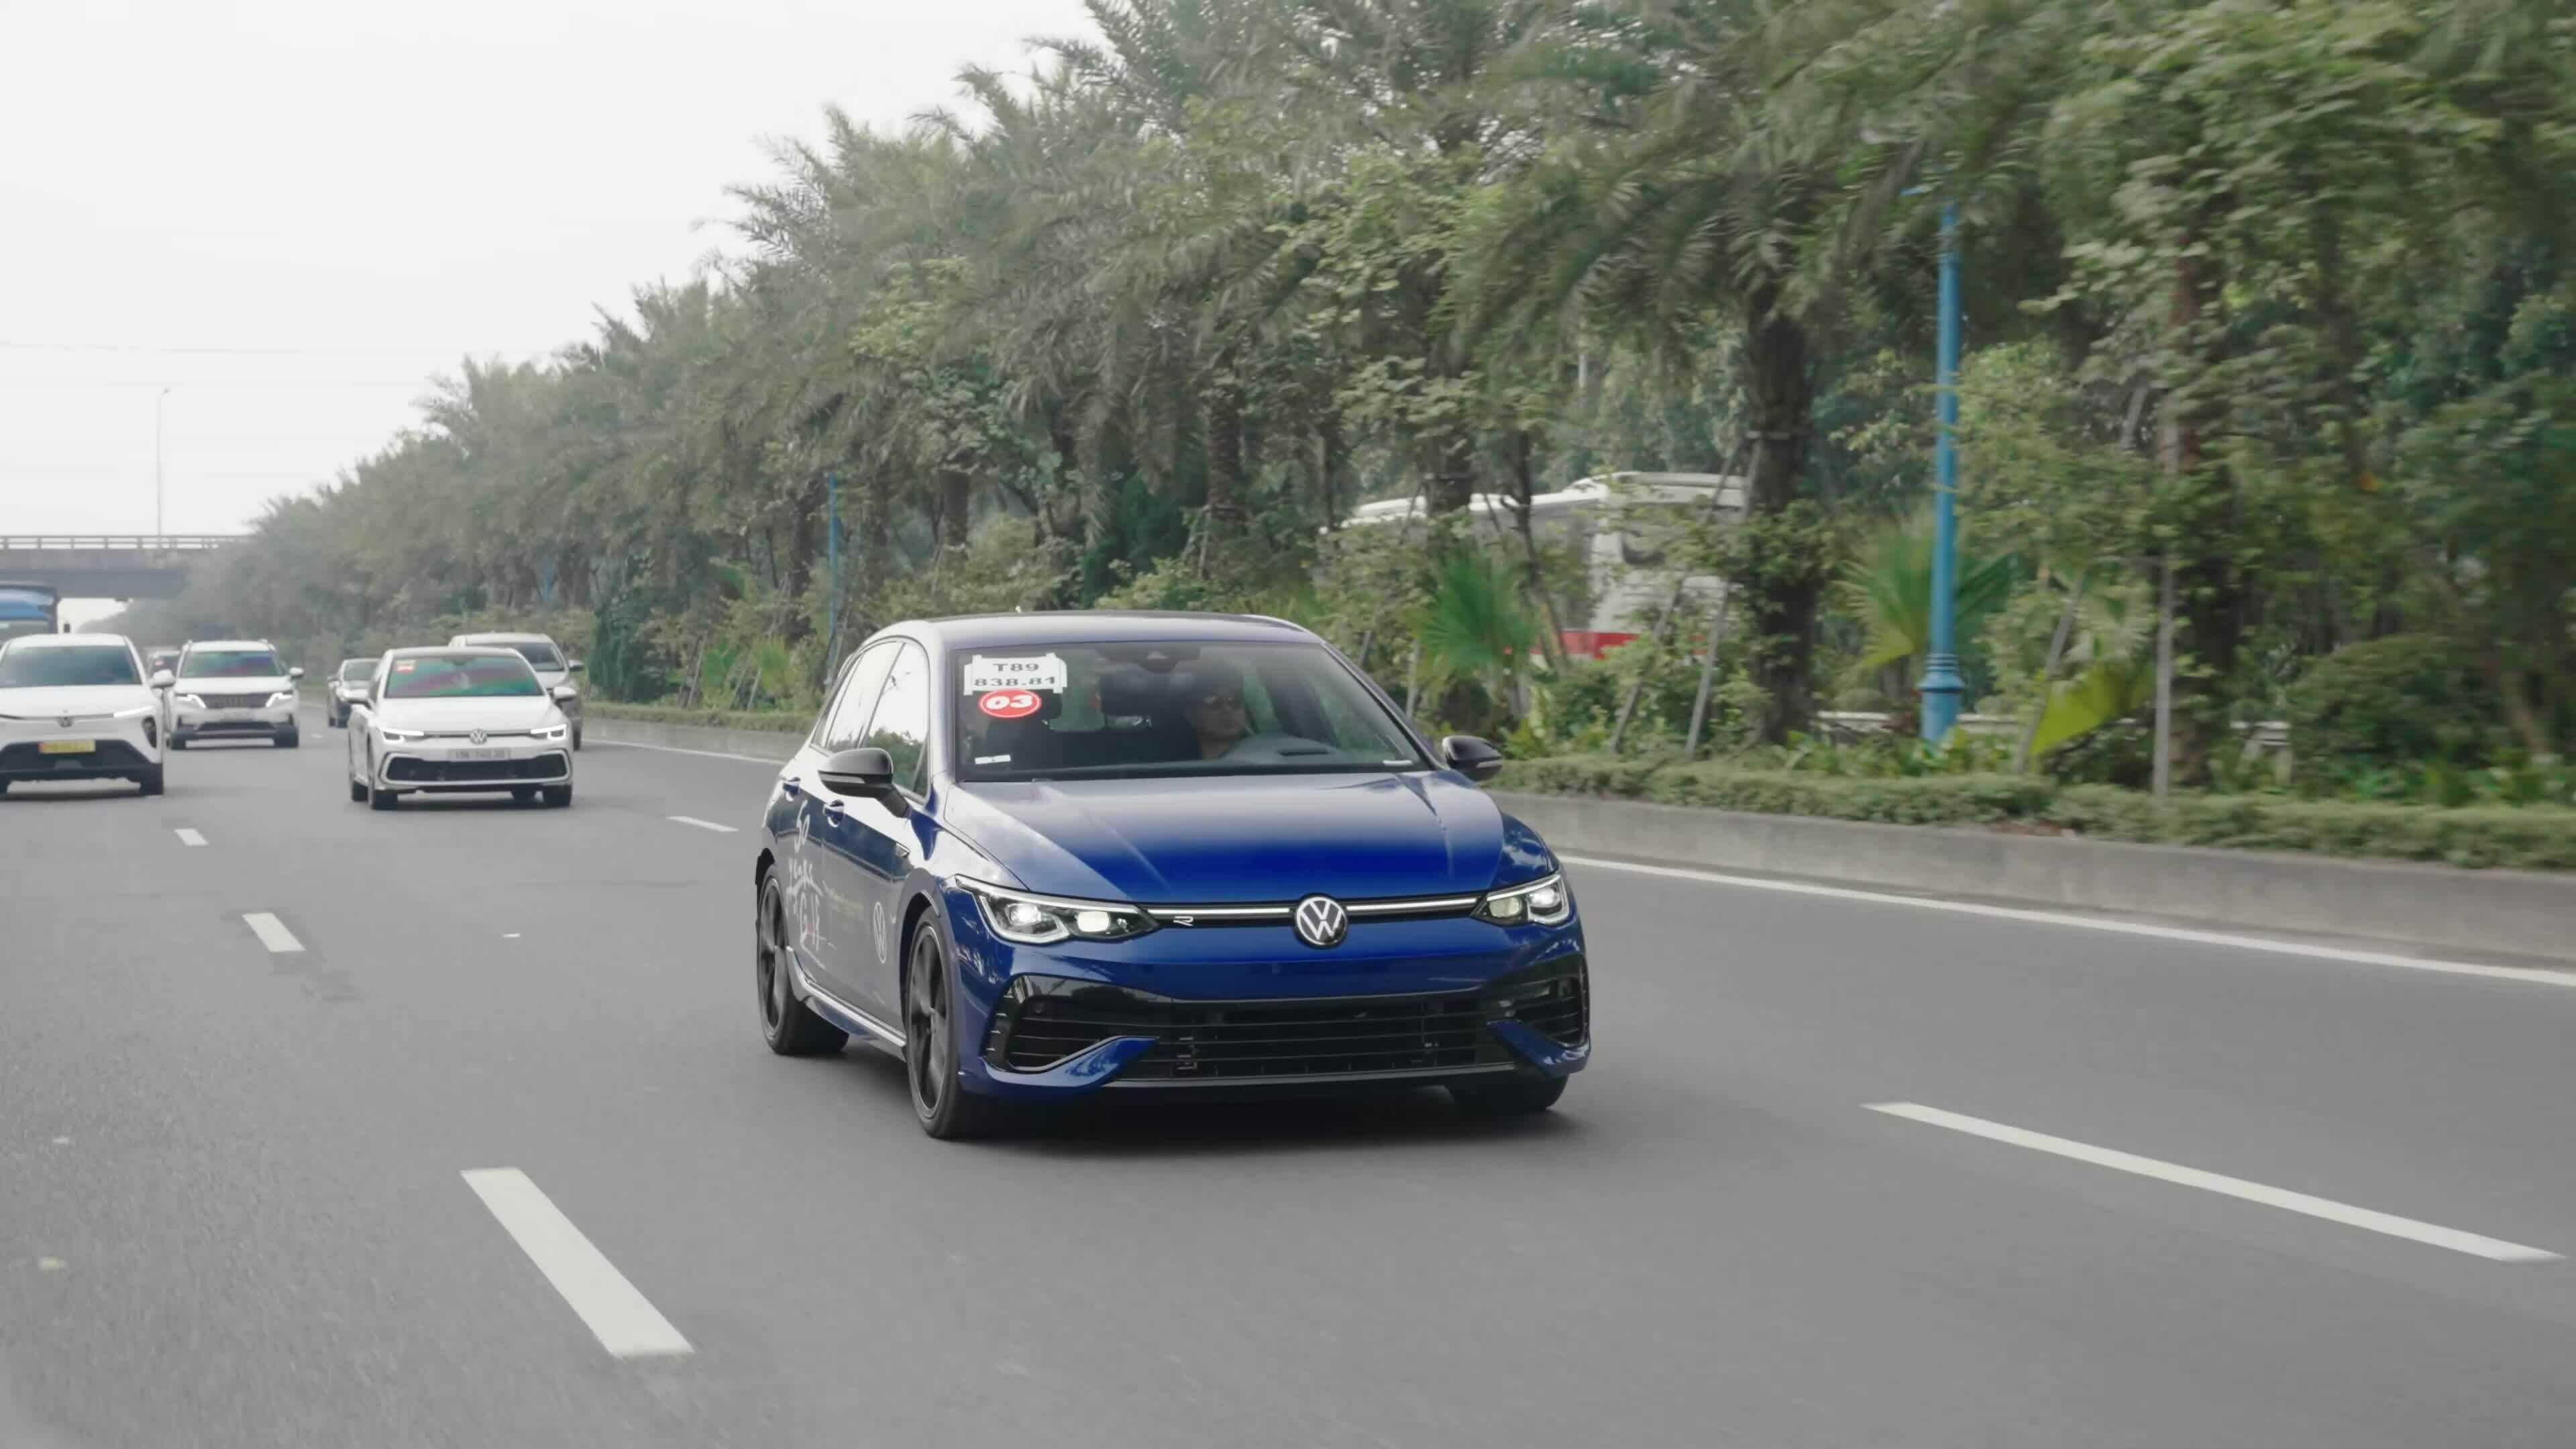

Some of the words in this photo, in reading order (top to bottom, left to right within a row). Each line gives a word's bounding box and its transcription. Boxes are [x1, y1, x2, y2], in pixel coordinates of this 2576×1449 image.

[992, 663, 1040, 672] T89
[974, 676, 1056, 687] 838.81
[985, 695, 1034, 710] 03
[1298, 898, 1344, 943] VW
